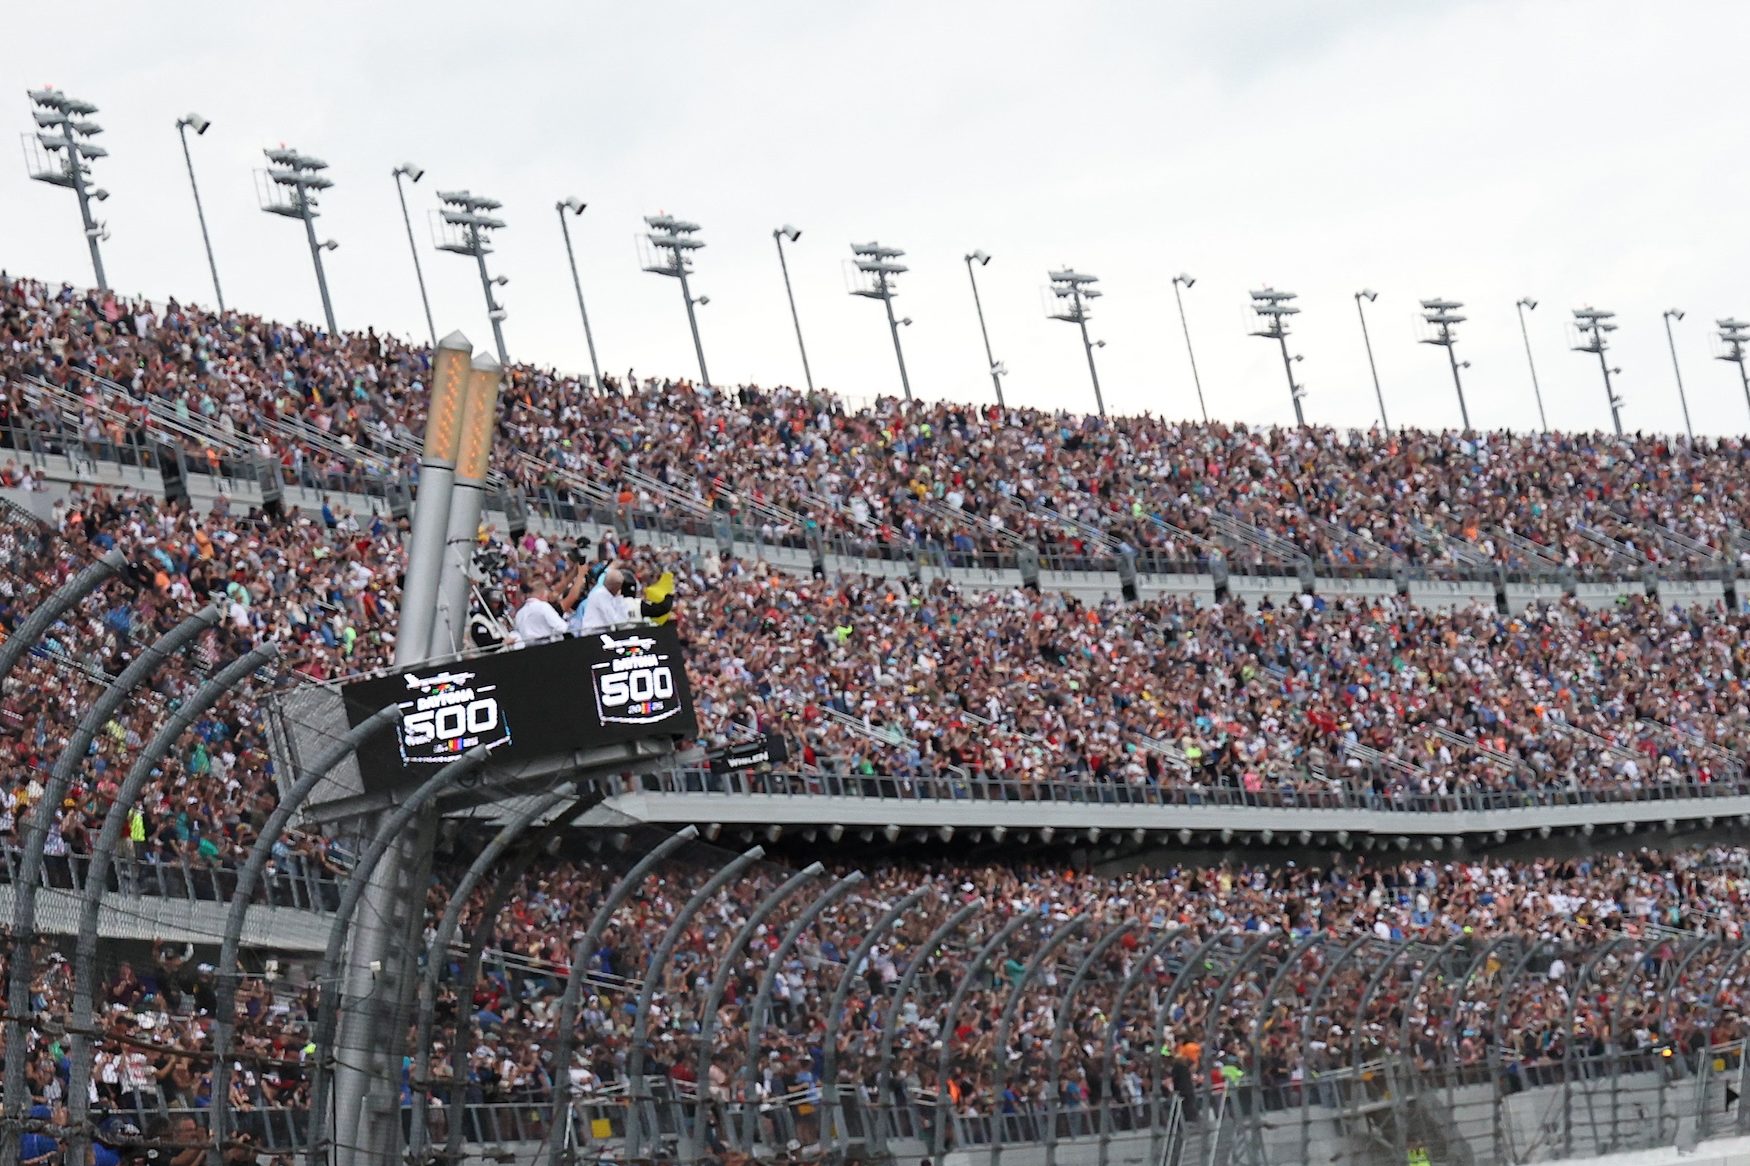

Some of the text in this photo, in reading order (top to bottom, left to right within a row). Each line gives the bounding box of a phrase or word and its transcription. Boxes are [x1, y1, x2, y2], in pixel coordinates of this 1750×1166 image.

[417, 687, 475, 711] DAYTONA
[600, 666, 674, 707] 500
[403, 697, 498, 747] 500
